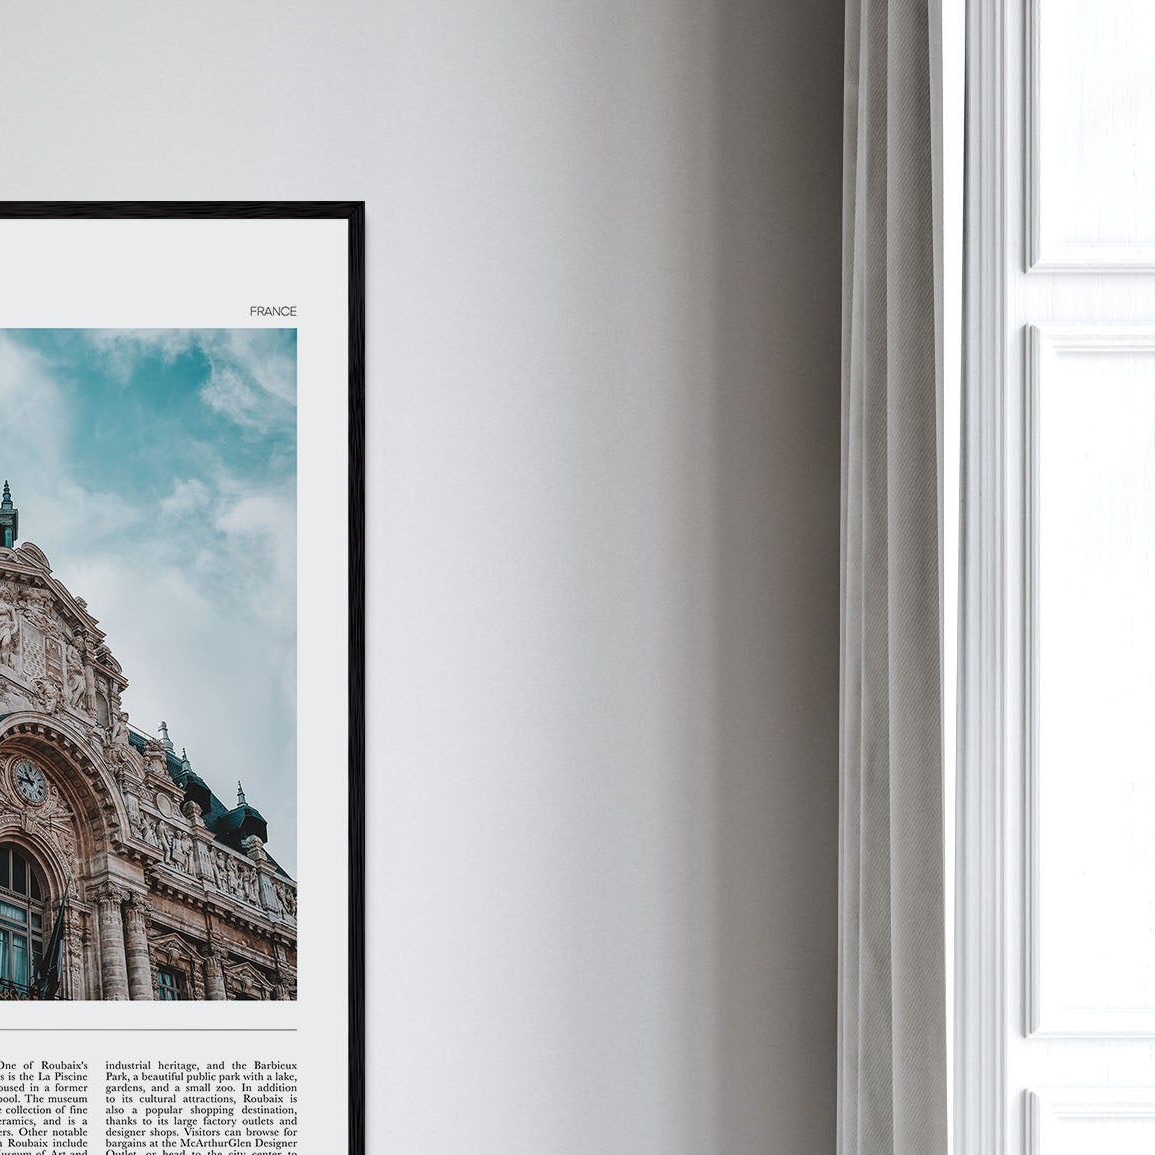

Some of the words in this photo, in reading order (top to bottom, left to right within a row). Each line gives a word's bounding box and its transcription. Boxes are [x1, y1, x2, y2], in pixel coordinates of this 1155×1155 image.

[250, 306, 297, 316] FRANCE
[23, 1061, 33, 1069] of
[41, 1061, 88, 1069] Roubaix's
[105, 1061, 150, 1069] industrial
[158, 1061, 199, 1072] heritage,
[206, 1061, 224, 1069] and
[231, 1061, 246, 1069] the
[254, 1061, 297, 1069] Barbieux
[8, 1072, 15, 1080] is
[19, 1072, 34, 1080] the
[38, 1072, 50, 1080] La
[55, 1072, 87, 1080] Piscine
[106, 1072, 130, 1082] Park,
[141, 1072, 183, 1080] beautiful
[186, 1072, 216, 1083] public
[219, 1072, 240, 1083] park
[243, 1072, 263, 1080] with
[275, 1072, 297, 1082] lake,
[105, 1083, 145, 1094] gardens,
[151, 1083, 169, 1092] and
[185, 1083, 210, 1092] small
[242, 1083, 251, 1092] In
[257, 1083, 297, 1092] addition
[25, 1094, 44, 1103] The
[5, 1105, 51, 1114] collection
[55, 1105, 65, 1114] of
[70, 1105, 87, 1114] fine
[105, 1105, 124, 1114] also
[145, 1105, 182, 1116] popular
[190, 1105, 234, 1116] shopping
[241, 1105, 297, 1116] destination,
[105, 1116, 137, 1125] thanks
[142, 1116, 152, 1125] to
[157, 1116, 168, 1125] its
[174, 1116, 197, 1127] large
[203, 1116, 236, 1127] factory
[242, 1116, 274, 1125] outlets
[279, 1116, 297, 1125] and
[18, 1127, 48, 1136] Other
[52, 1127, 87, 1136] notable
[105, 1127, 146, 1138] designer
[150, 1127, 178, 1138] shops.
[184, 1127, 220, 1136] Visitors
[246, 1127, 279, 1136] browse
[283, 1127, 297, 1136] for
[8, 1138, 48, 1147] Roubaix
[53, 1138, 87, 1147] include
[105, 1138, 146, 1150] bargains
[149, 1138, 158, 1147] at
[161, 1138, 176, 1147] the
[180, 1138, 251, 1147] McArthurGlen
[255, 1138, 297, 1150] Designer
